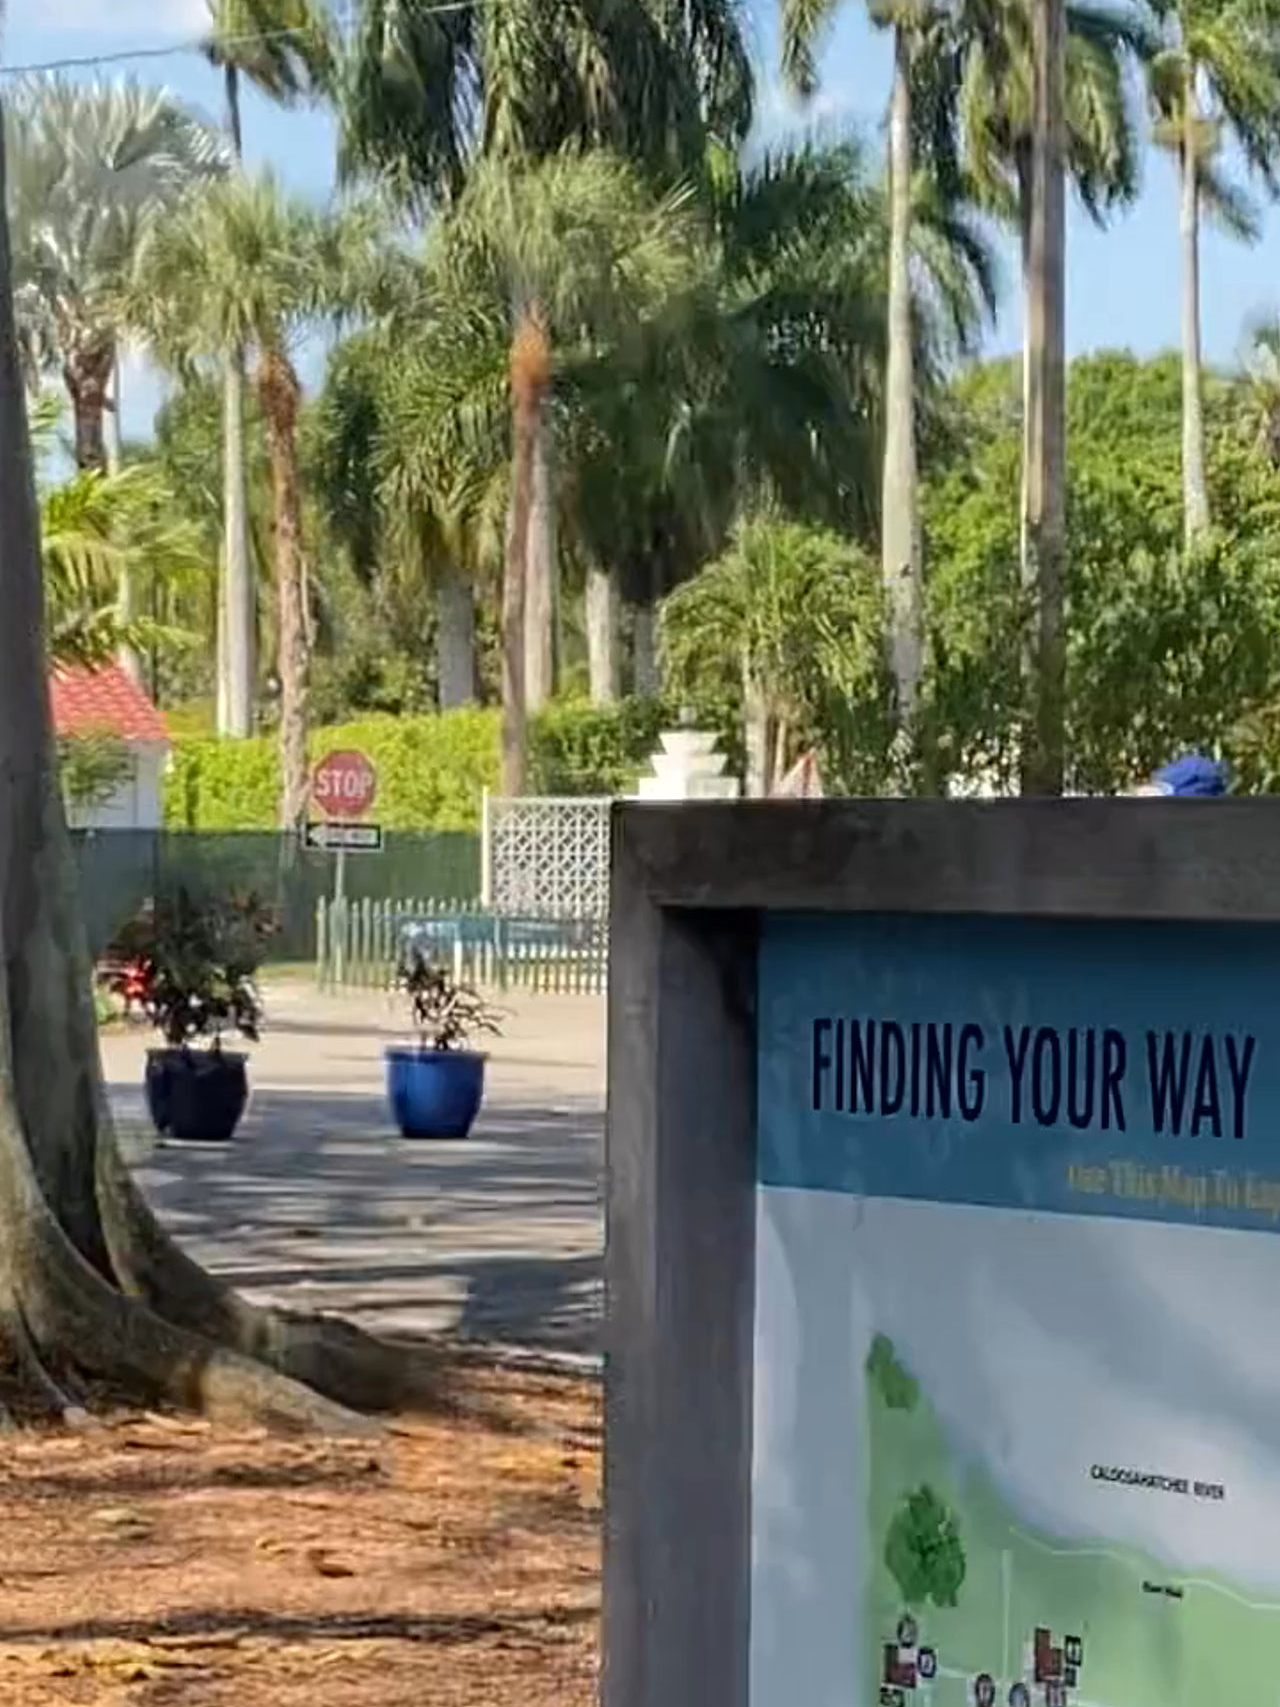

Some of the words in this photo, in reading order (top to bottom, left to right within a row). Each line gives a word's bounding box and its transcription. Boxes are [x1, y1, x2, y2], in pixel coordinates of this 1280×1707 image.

[317, 769, 373, 796] STOP
[811, 1017, 985, 1123] FINDING
[1002, 1023, 1128, 1133] YOUR
[1145, 1030, 1257, 1140] WAY
